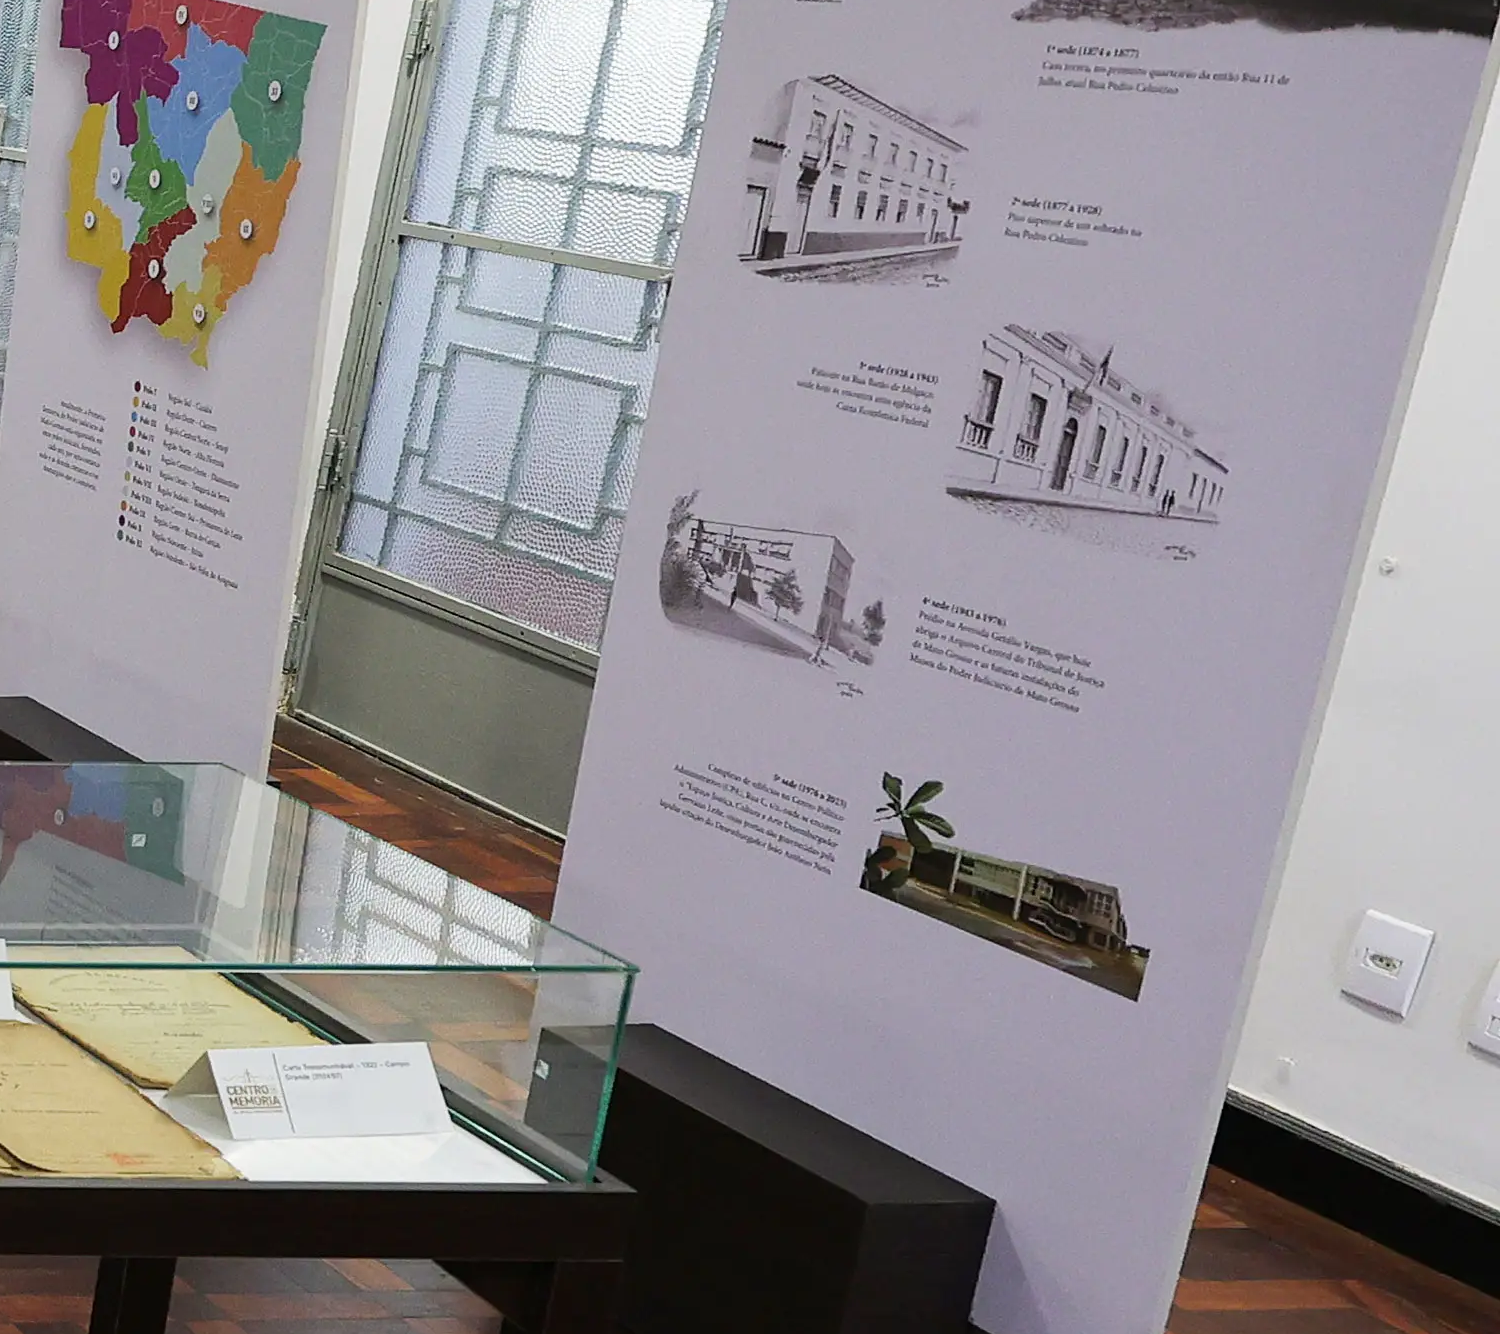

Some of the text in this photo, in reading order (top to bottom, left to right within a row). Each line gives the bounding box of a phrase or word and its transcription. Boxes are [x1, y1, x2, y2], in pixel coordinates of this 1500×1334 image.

[932, 600, 950, 611] sede
[1013, 654, 1025, 664] do
[1027, 656, 1063, 676] Tribunal
[1064, 667, 1075, 679] de
[227, 1085, 268, 1096] CENTRO
